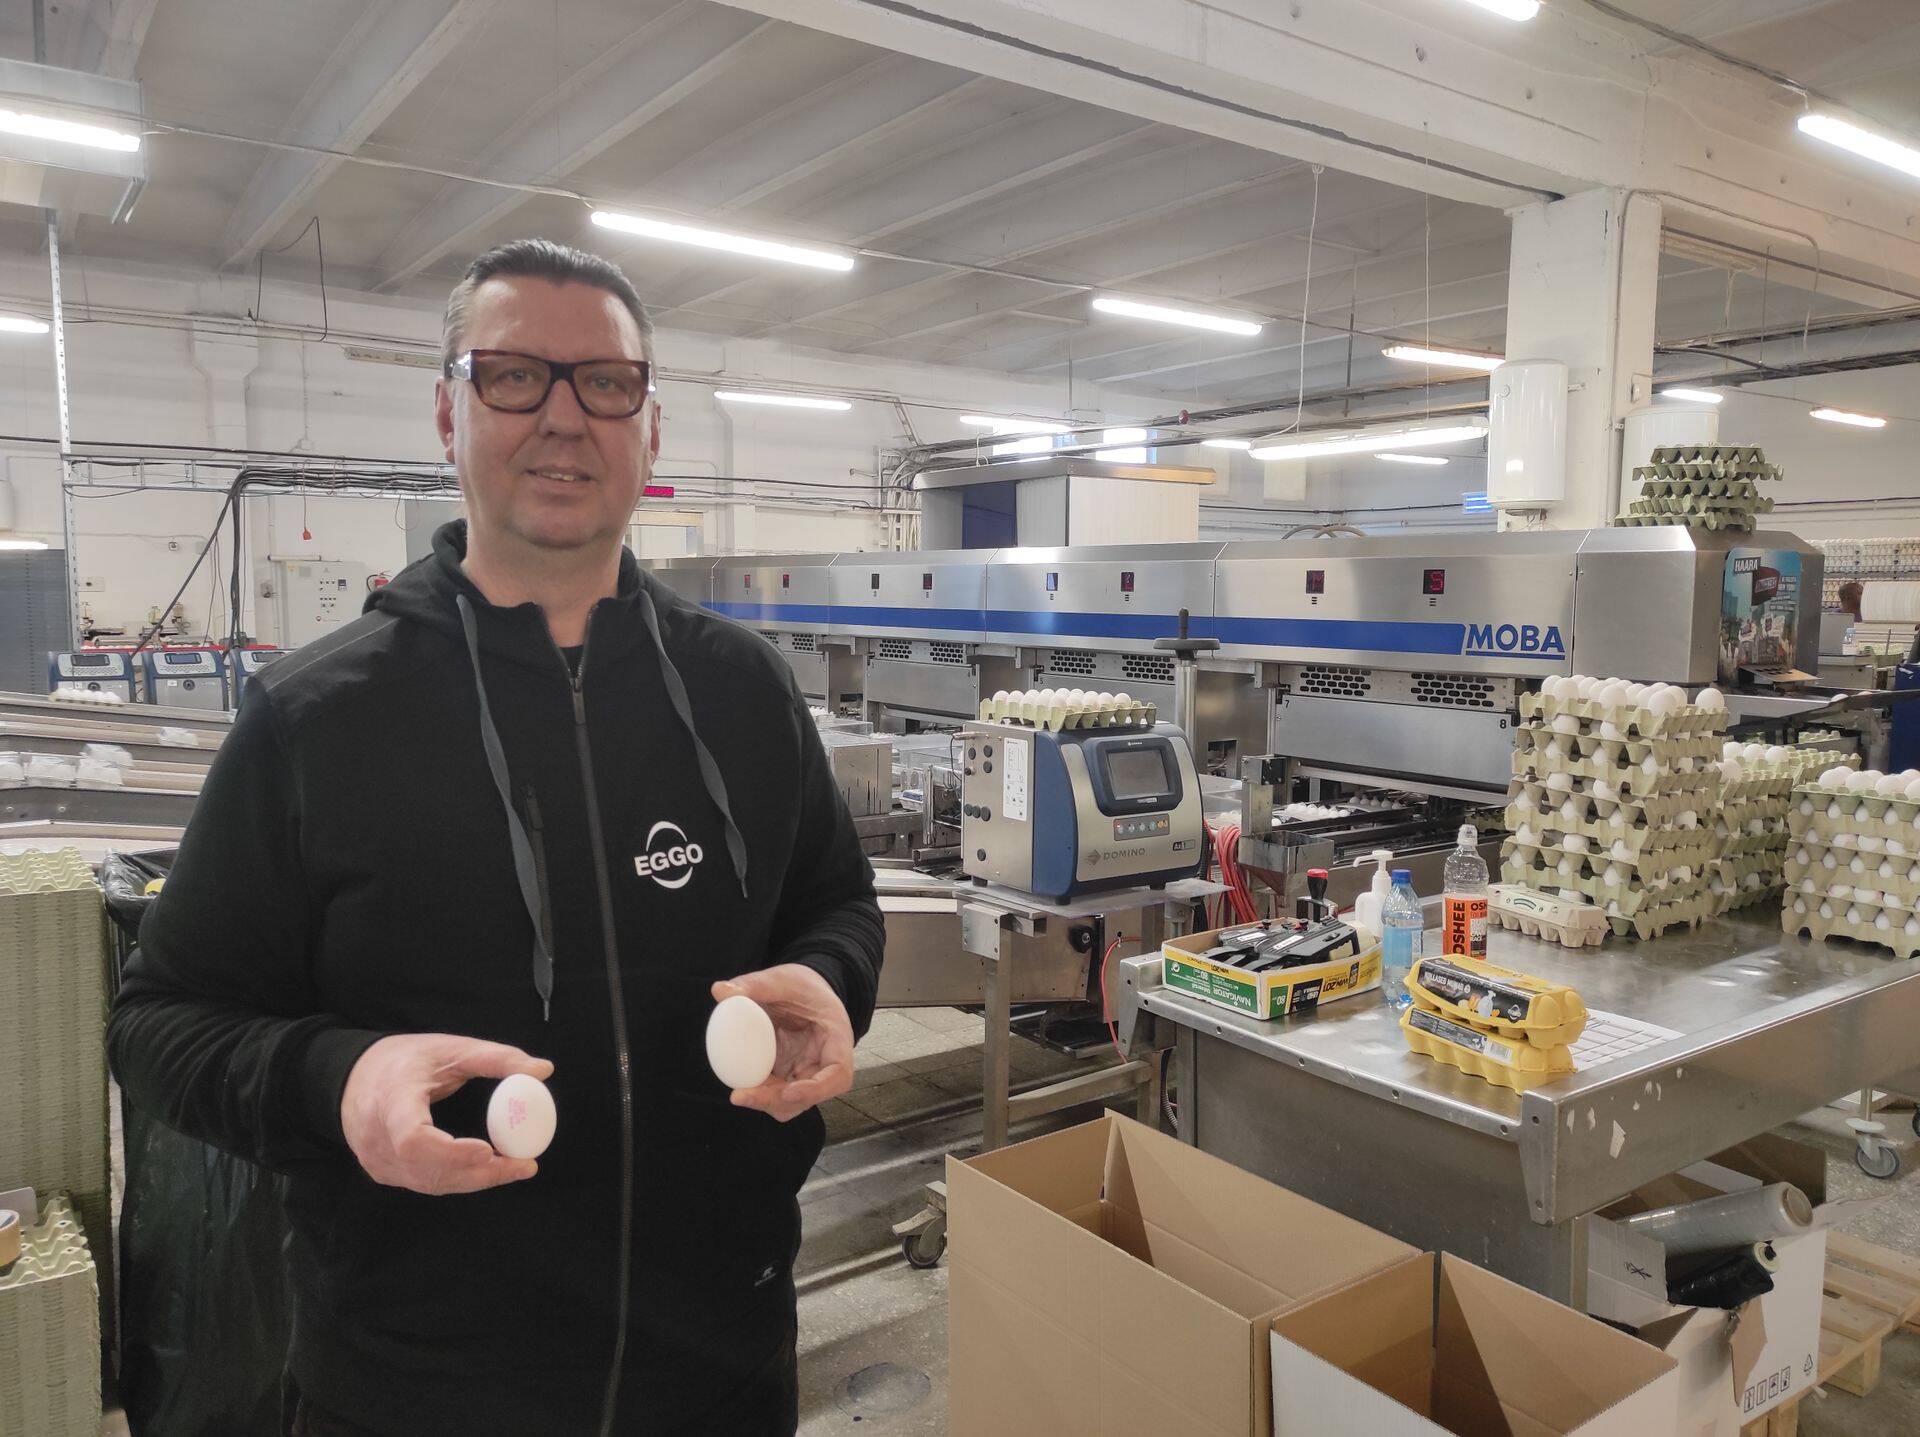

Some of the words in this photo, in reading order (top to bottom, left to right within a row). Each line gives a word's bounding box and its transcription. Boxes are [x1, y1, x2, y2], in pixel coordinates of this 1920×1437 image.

[1735, 560, 1758, 572] HAARA
[1467, 623, 1566, 652] MOBA
[1284, 699, 1290, 709] 7
[1499, 719, 1507, 729] 8
[634, 843, 703, 876] EGGO
[1103, 848, 1146, 860] DOMINO
[1213, 987, 1252, 1007] NAVIGATOR
[1276, 994, 1286, 1006] 80
